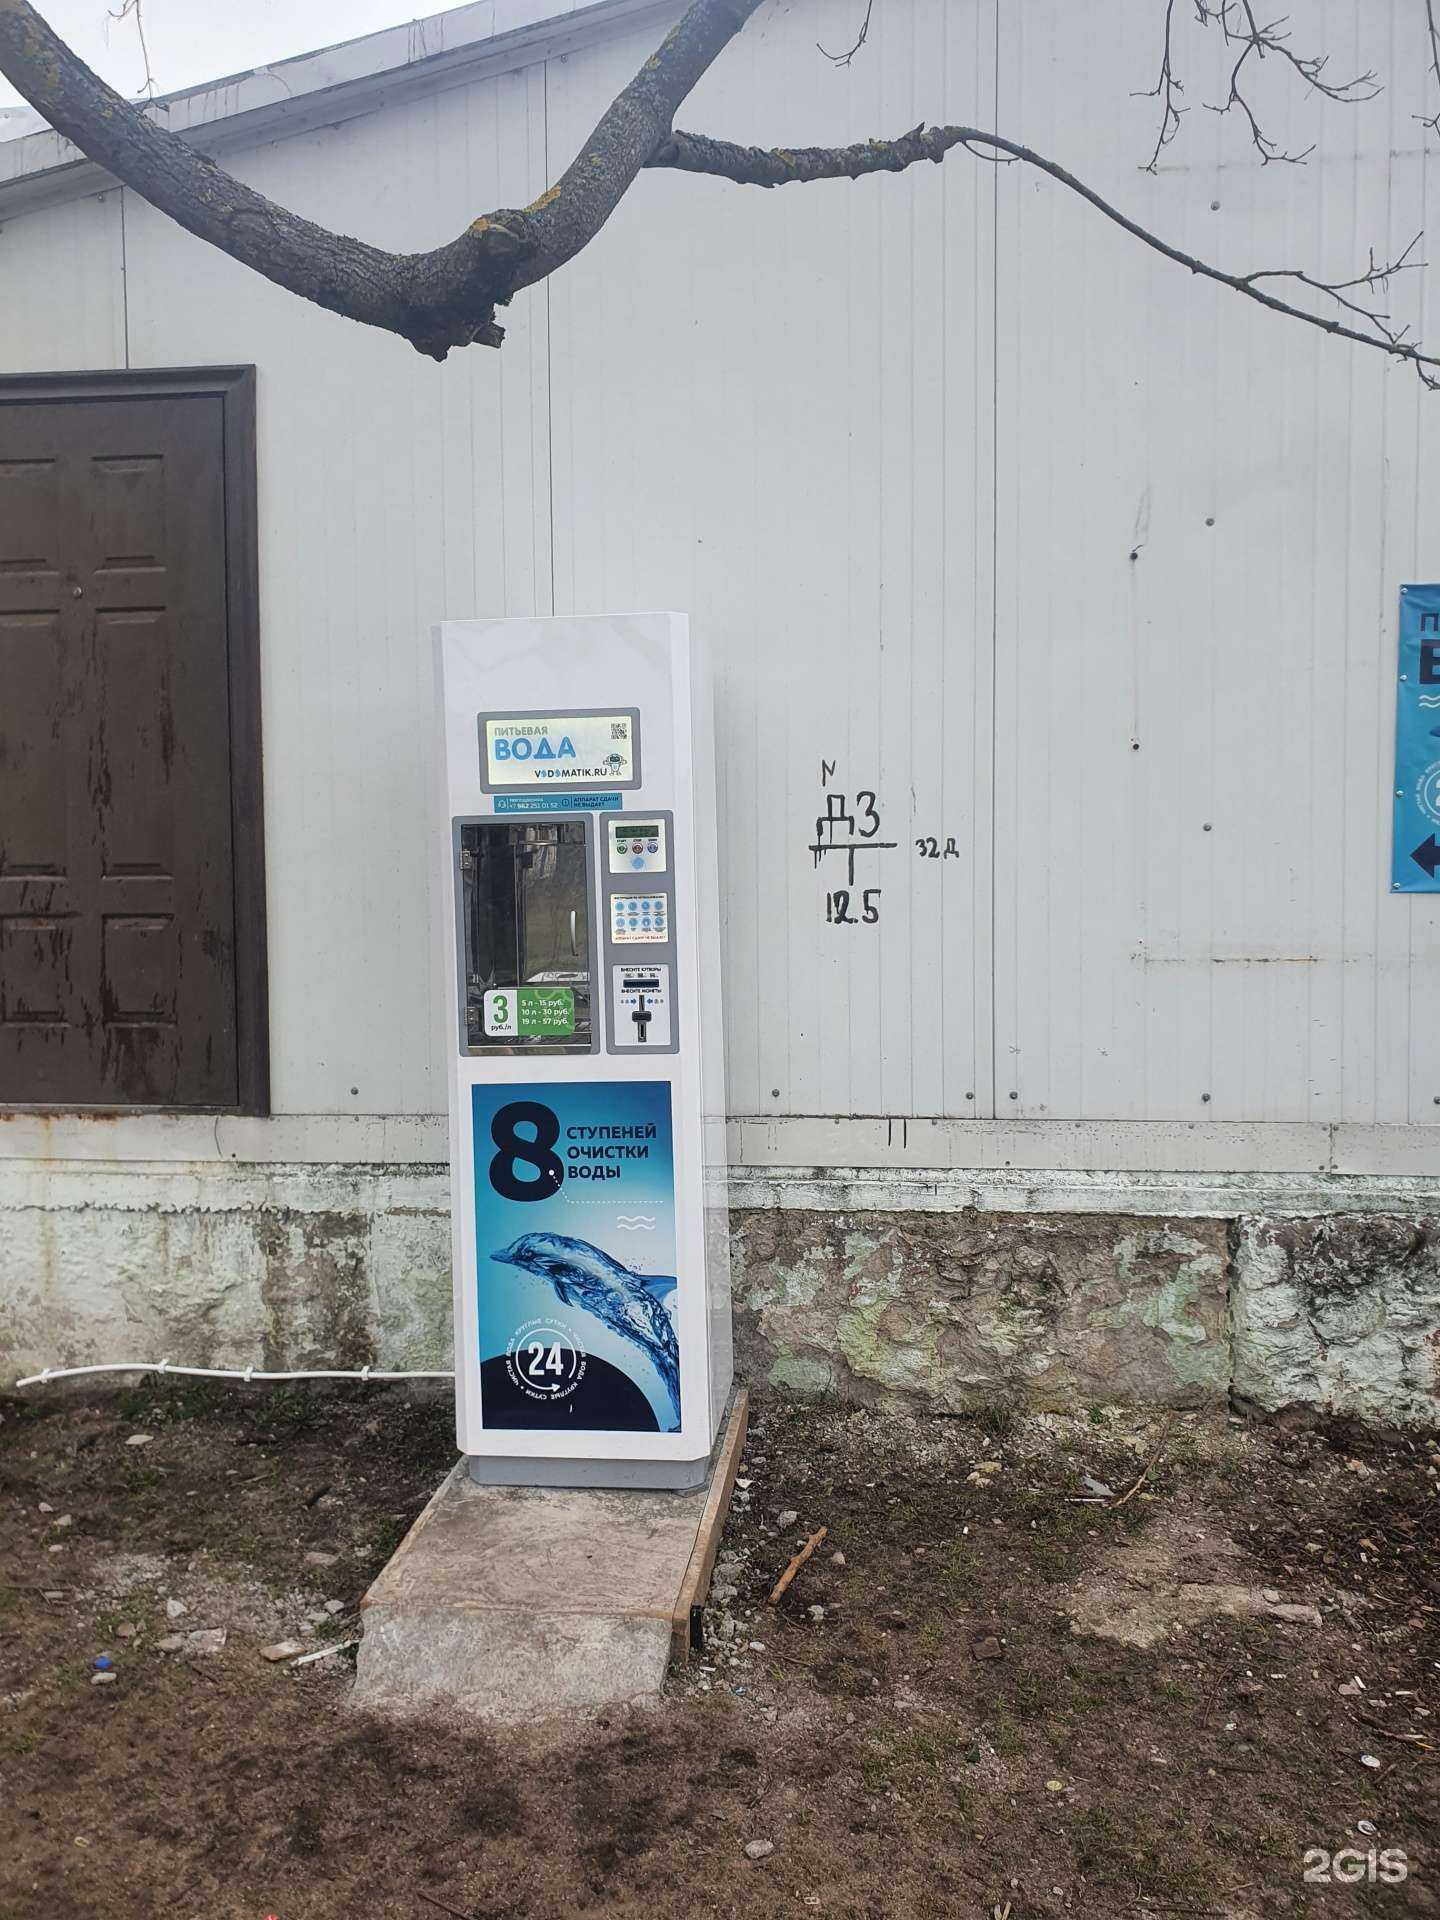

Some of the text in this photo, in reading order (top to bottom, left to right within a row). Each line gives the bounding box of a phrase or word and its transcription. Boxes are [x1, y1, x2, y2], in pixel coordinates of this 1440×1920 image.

[494, 726, 549, 736] ПИТЬЕВАЯ
[495, 736, 576, 760] ВОДА
[493, 995, 509, 1024] 3
[554, 1008, 570, 1017] руб.
[566, 1122, 657, 1139] СТУПЕНЕЙ
[489, 1101, 564, 1202] 8
[567, 1145, 649, 1159] ОЧИСТКИ
[567, 1165, 621, 1180] ВОДЫ
[528, 1341, 564, 1376] 24
